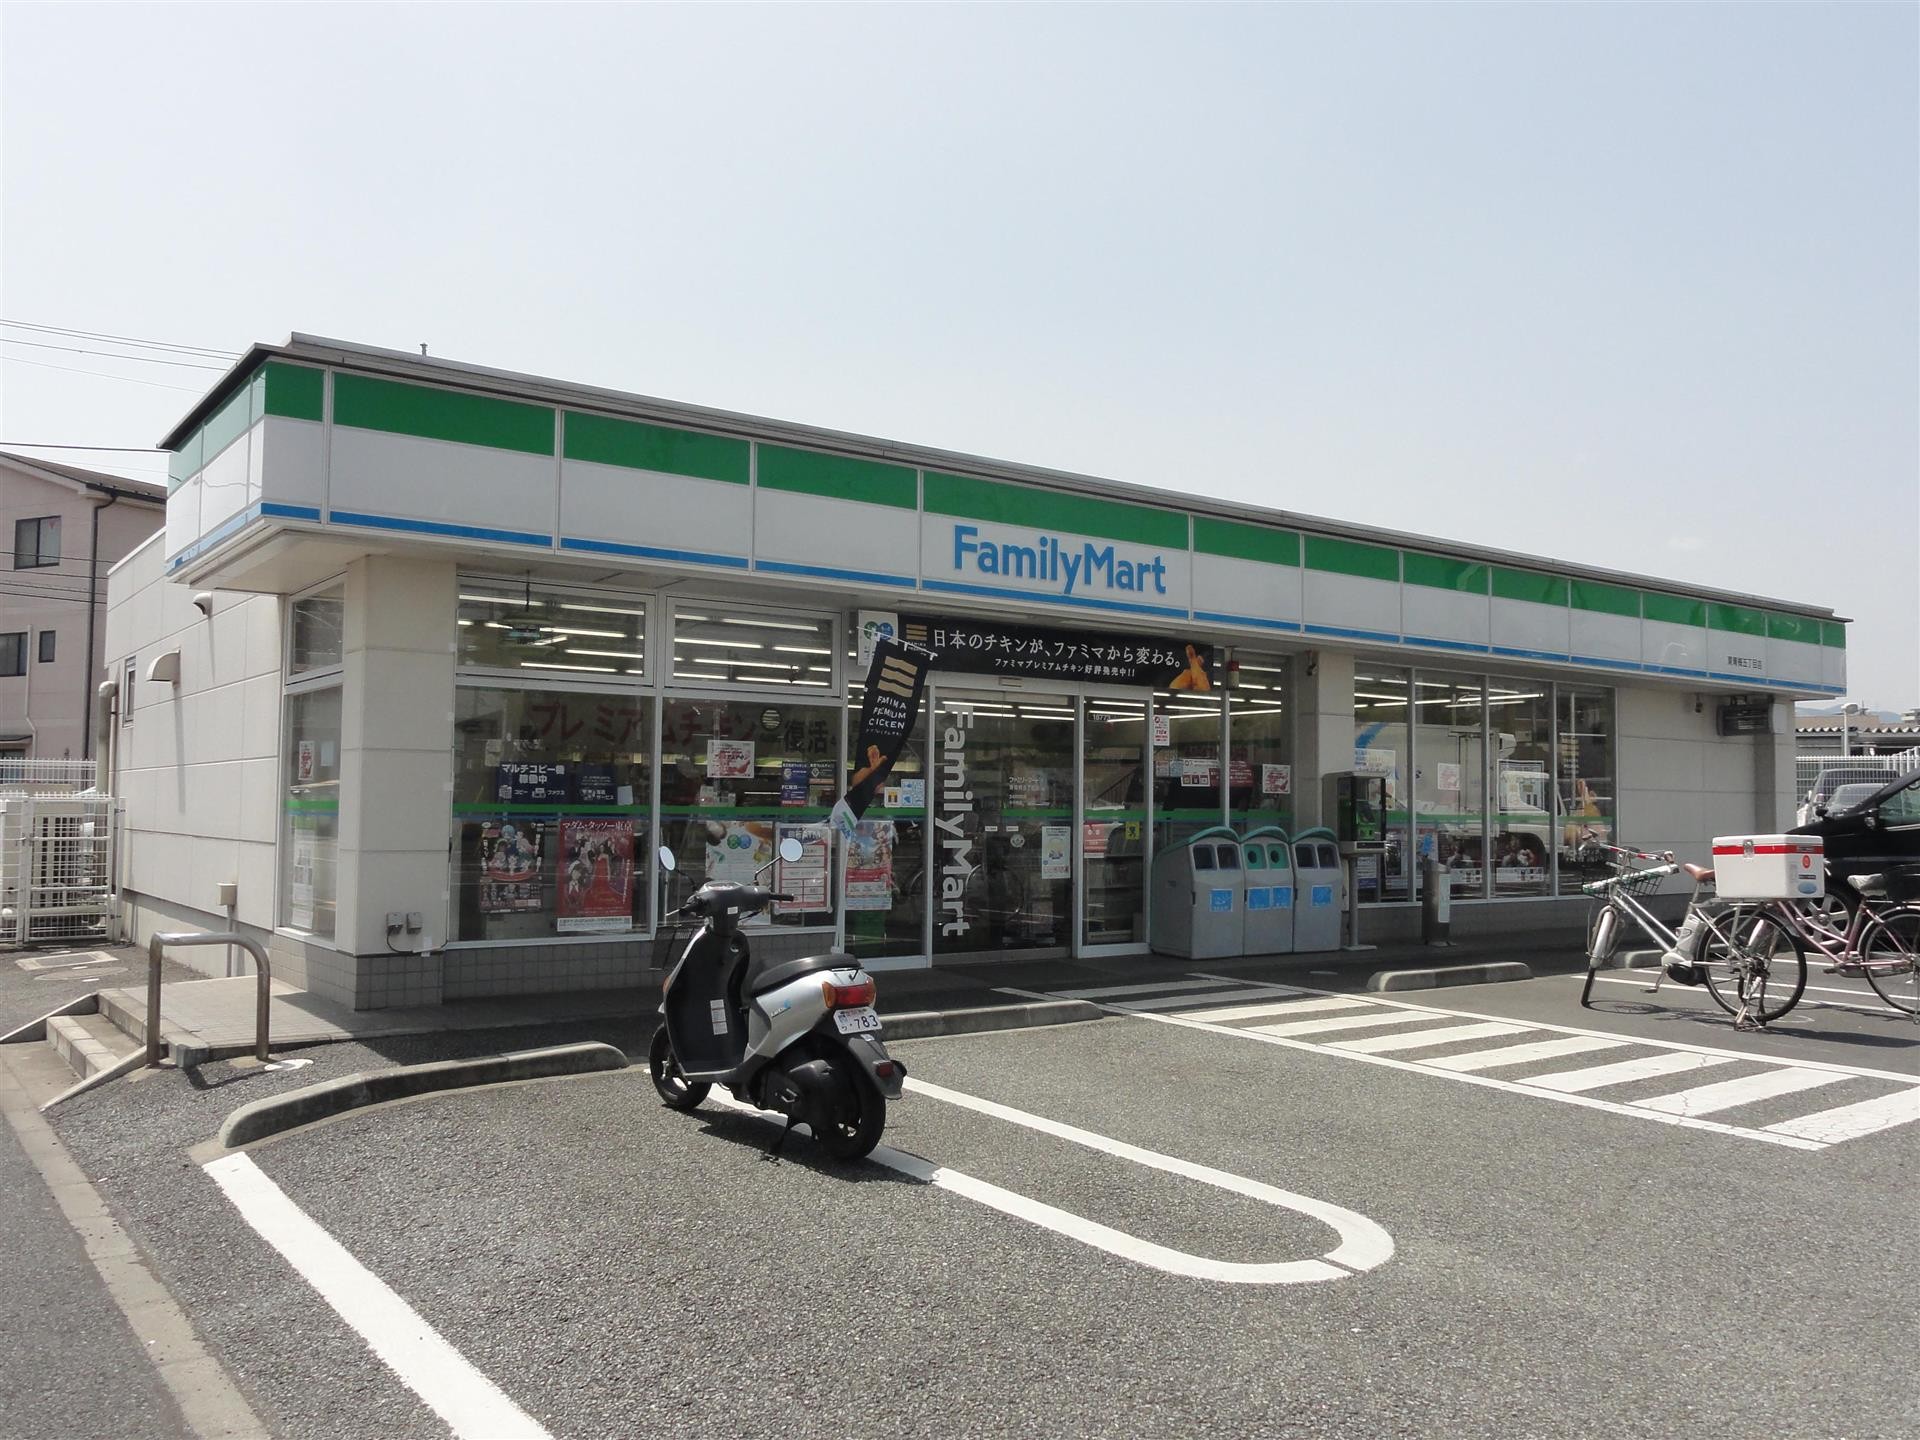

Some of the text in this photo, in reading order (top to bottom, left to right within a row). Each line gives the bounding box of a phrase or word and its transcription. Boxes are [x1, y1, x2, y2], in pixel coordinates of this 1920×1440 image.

[953, 524, 1167, 595] FamilyMart
[933, 628, 1181, 669] 日本のチキンが、ファミマから変わる。
[934, 704, 974, 937] FamilyMart
[854, 1015, 879, 1030] 783
